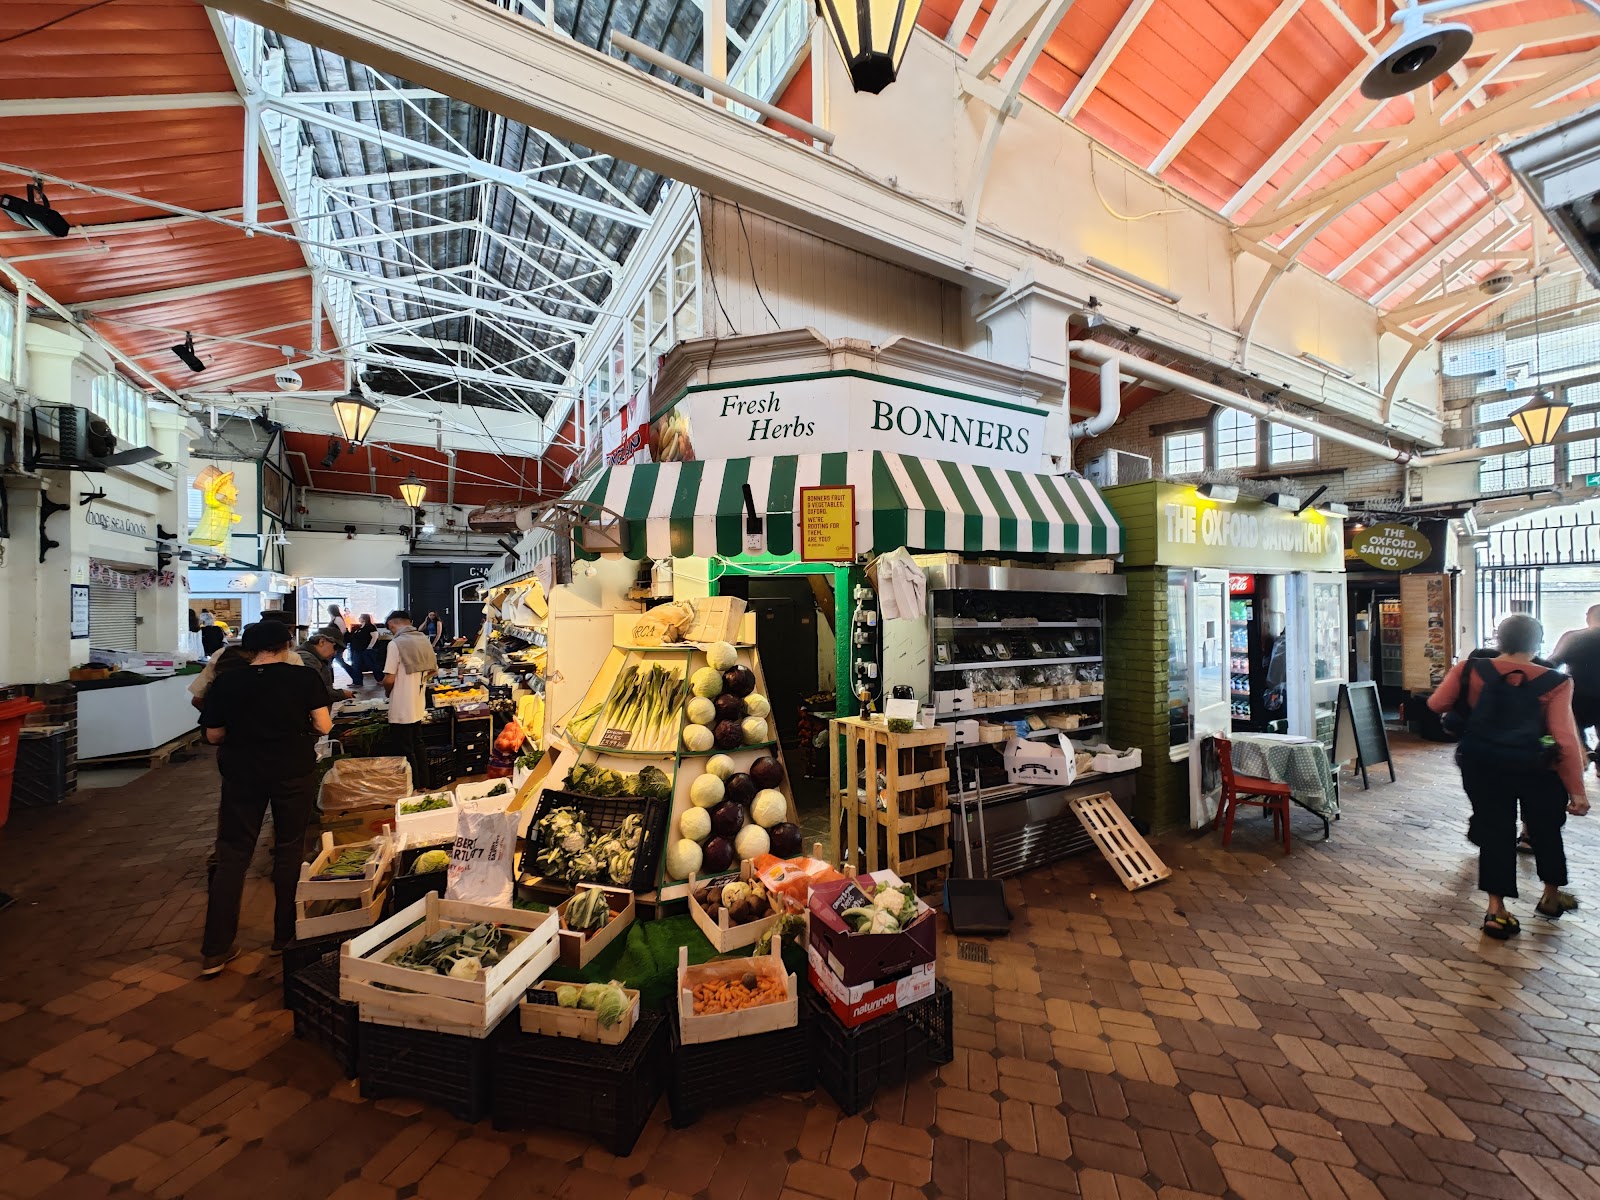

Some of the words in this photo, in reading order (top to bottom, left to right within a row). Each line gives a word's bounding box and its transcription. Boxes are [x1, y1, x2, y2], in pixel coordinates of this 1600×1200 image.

[720, 391, 780, 417] Fresh
[747, 416, 815, 441] Herbs
[871, 399, 1030, 454] BONNERS
[1165, 504, 1196, 544] THE
[1202, 508, 1259, 549] OXFORD
[1262, 515, 1321, 554] SANDWICH
[1384, 528, 1406, 538] THE
[1360, 544, 1424, 560] SANDWICH
[1369, 536, 1417, 549] OXFORD
[1380, 557, 1399, 567] CO.
